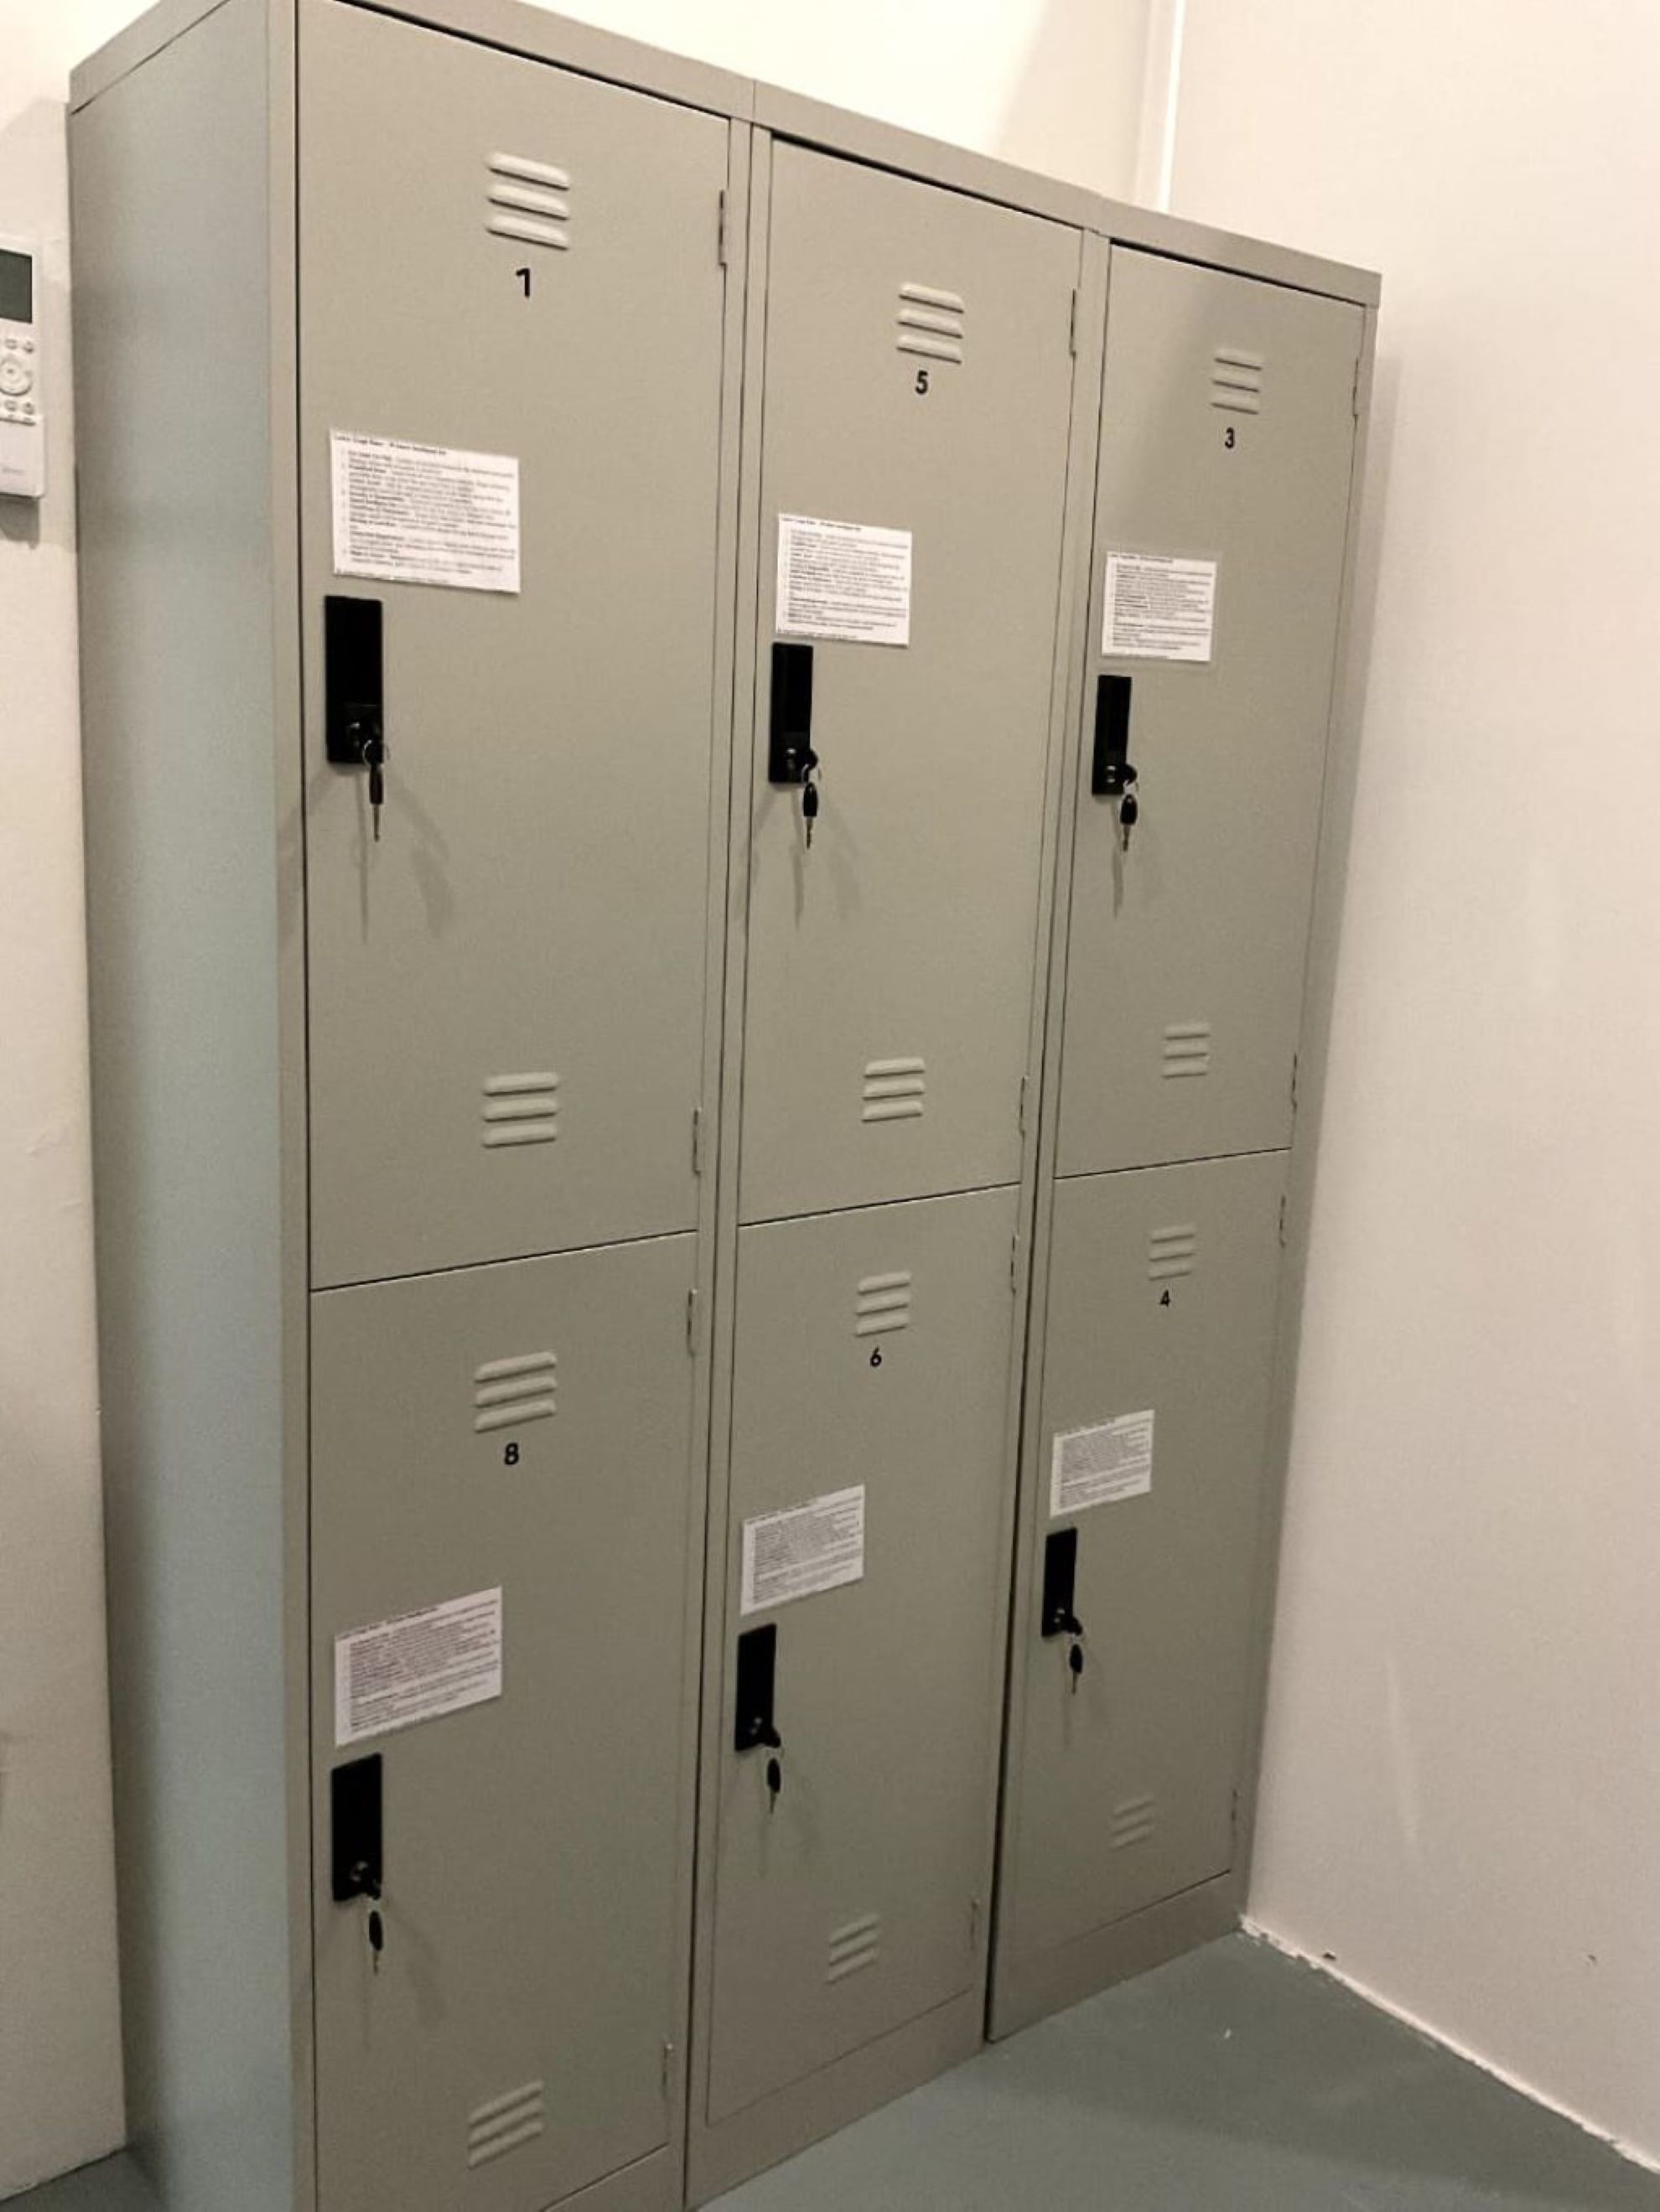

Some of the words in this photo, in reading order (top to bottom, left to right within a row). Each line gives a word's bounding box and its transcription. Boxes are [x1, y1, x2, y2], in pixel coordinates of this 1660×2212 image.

[516, 267, 531, 298] 1
[915, 370, 928, 395] 5
[1224, 427, 1235, 449] 3
[1159, 1289, 1171, 1308] 4
[869, 1347, 882, 1368] 6
[503, 1443, 520, 1466] 8
